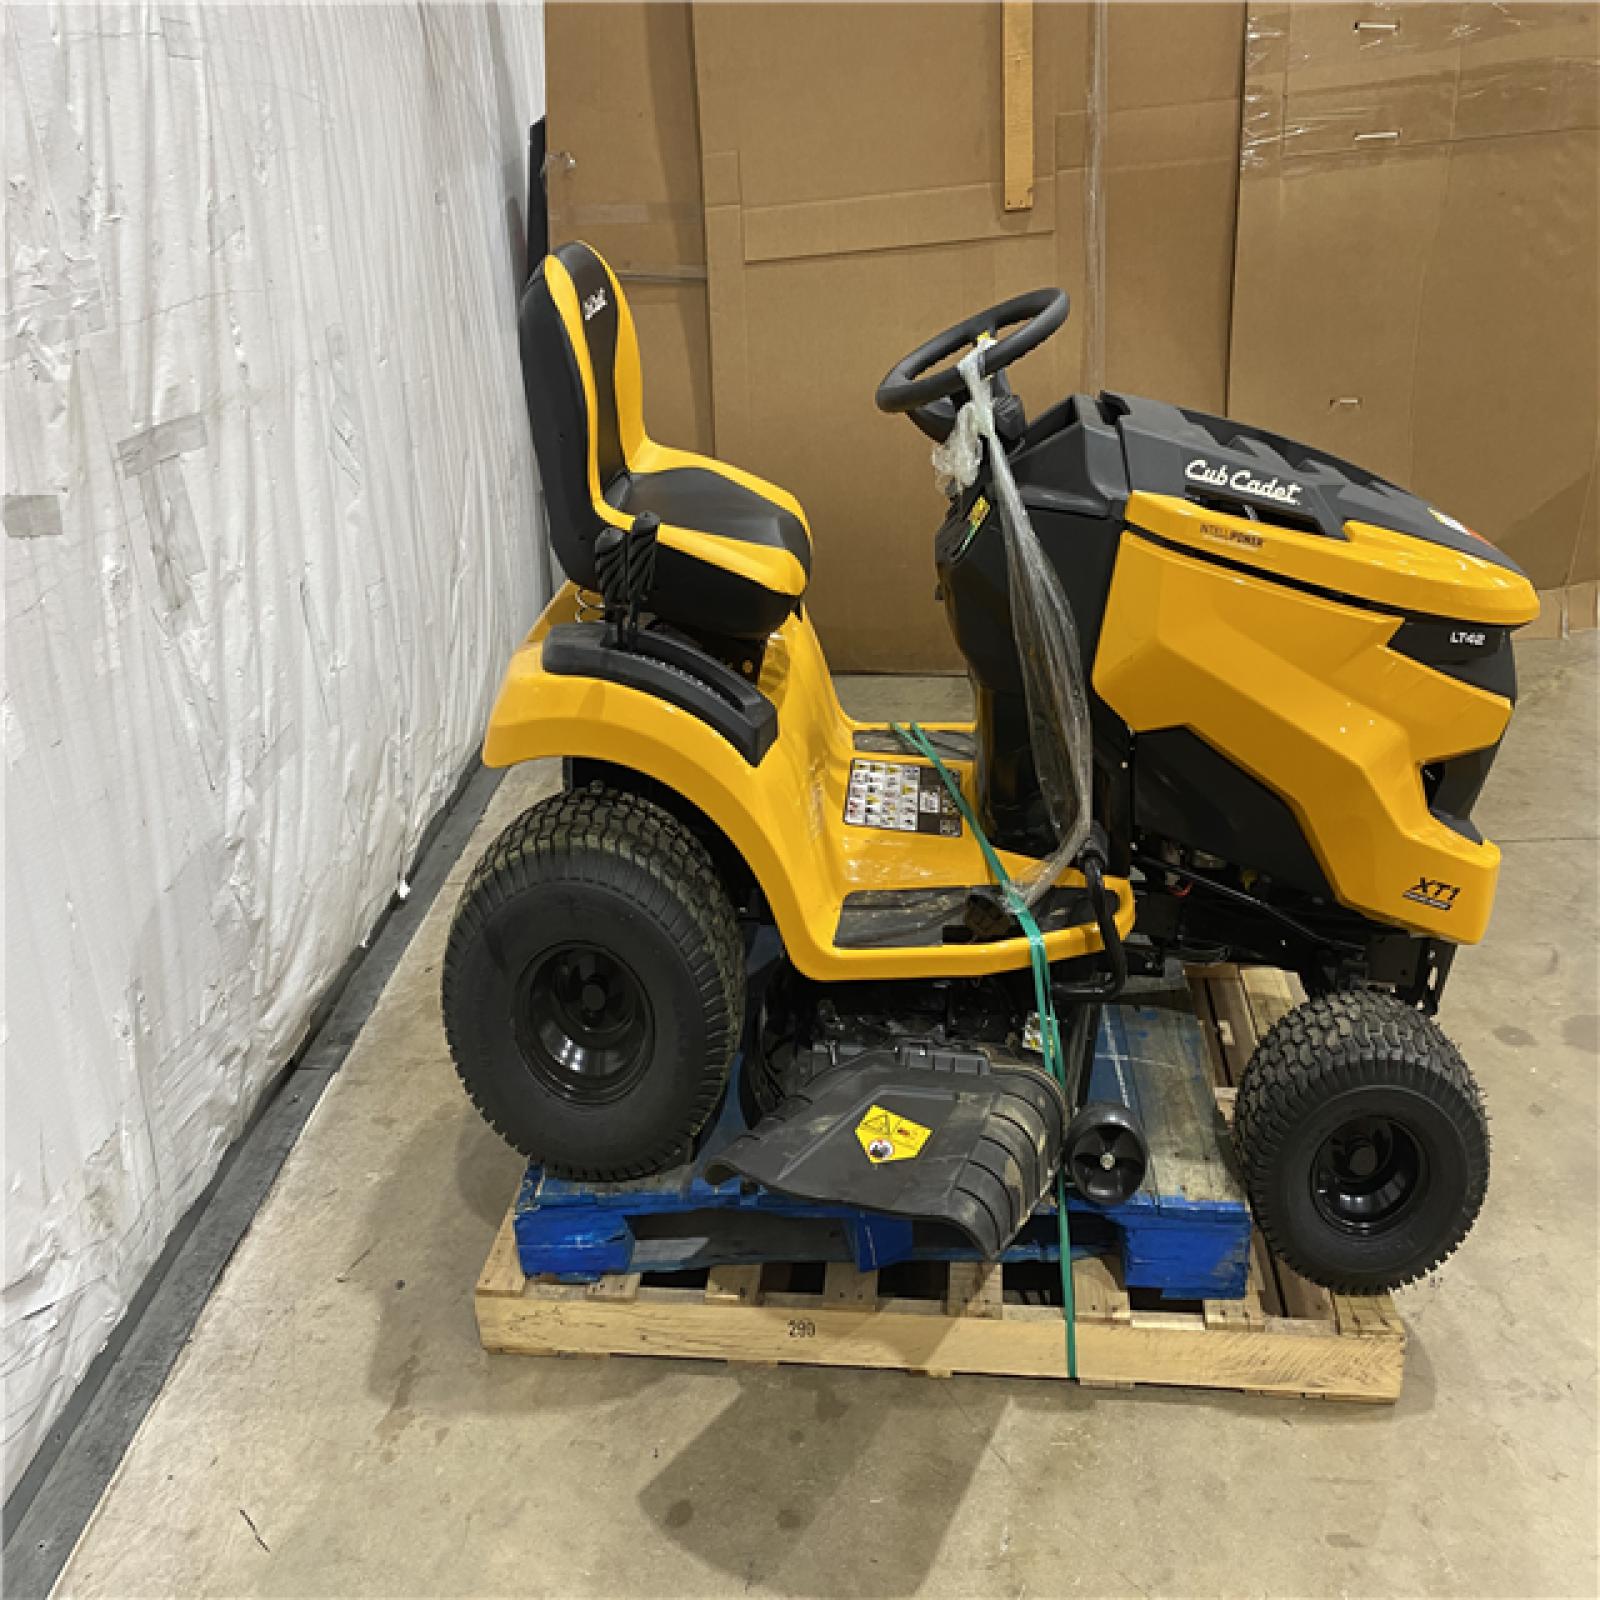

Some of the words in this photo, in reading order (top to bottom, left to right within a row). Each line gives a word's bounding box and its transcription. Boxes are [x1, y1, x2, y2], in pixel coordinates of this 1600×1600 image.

[1185, 459, 1228, 486] Cub
[1229, 469, 1302, 504] Cadet
[1405, 876, 1461, 901] XT1
